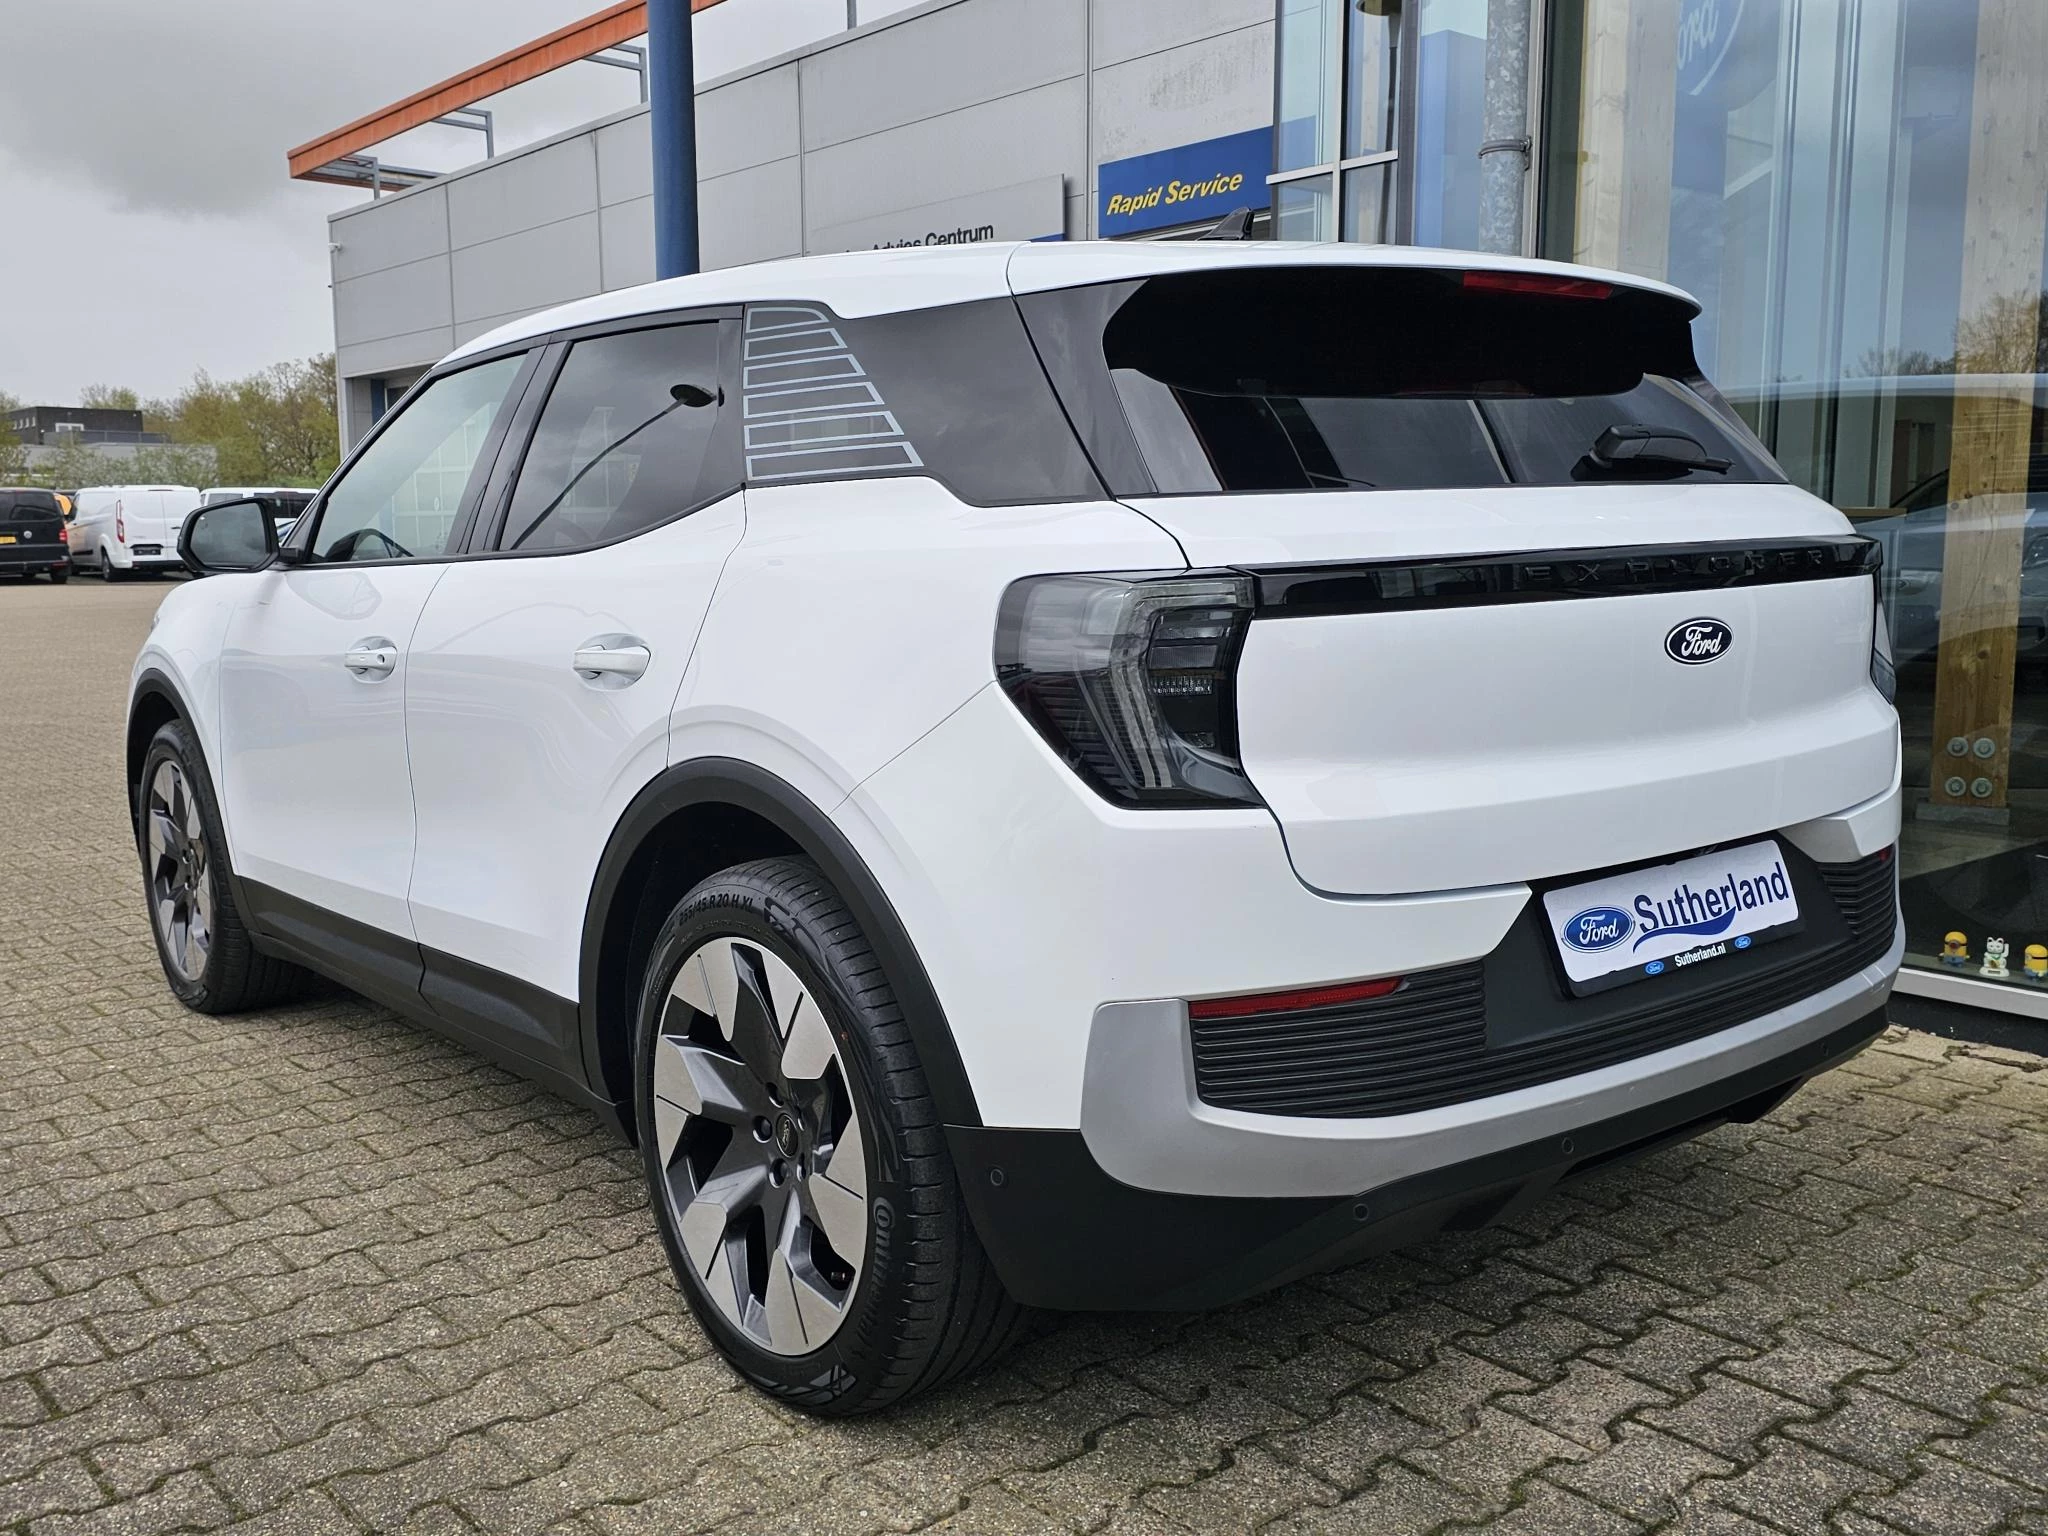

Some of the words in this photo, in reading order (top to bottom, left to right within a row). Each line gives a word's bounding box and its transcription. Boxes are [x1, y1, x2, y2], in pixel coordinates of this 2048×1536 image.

[1677, 0, 1719, 70] ord
[1106, 186, 1163, 215] Rapid
[1165, 173, 1243, 204] Service
[873, 238, 921, 251] ies
[925, 224, 994, 246] Centrum
[1681, 626, 1722, 656] Ford
[1634, 861, 1789, 934] Sutherland
[1579, 915, 1619, 945] Ford
[1674, 942, 1727, 967] Sutherland.nl
